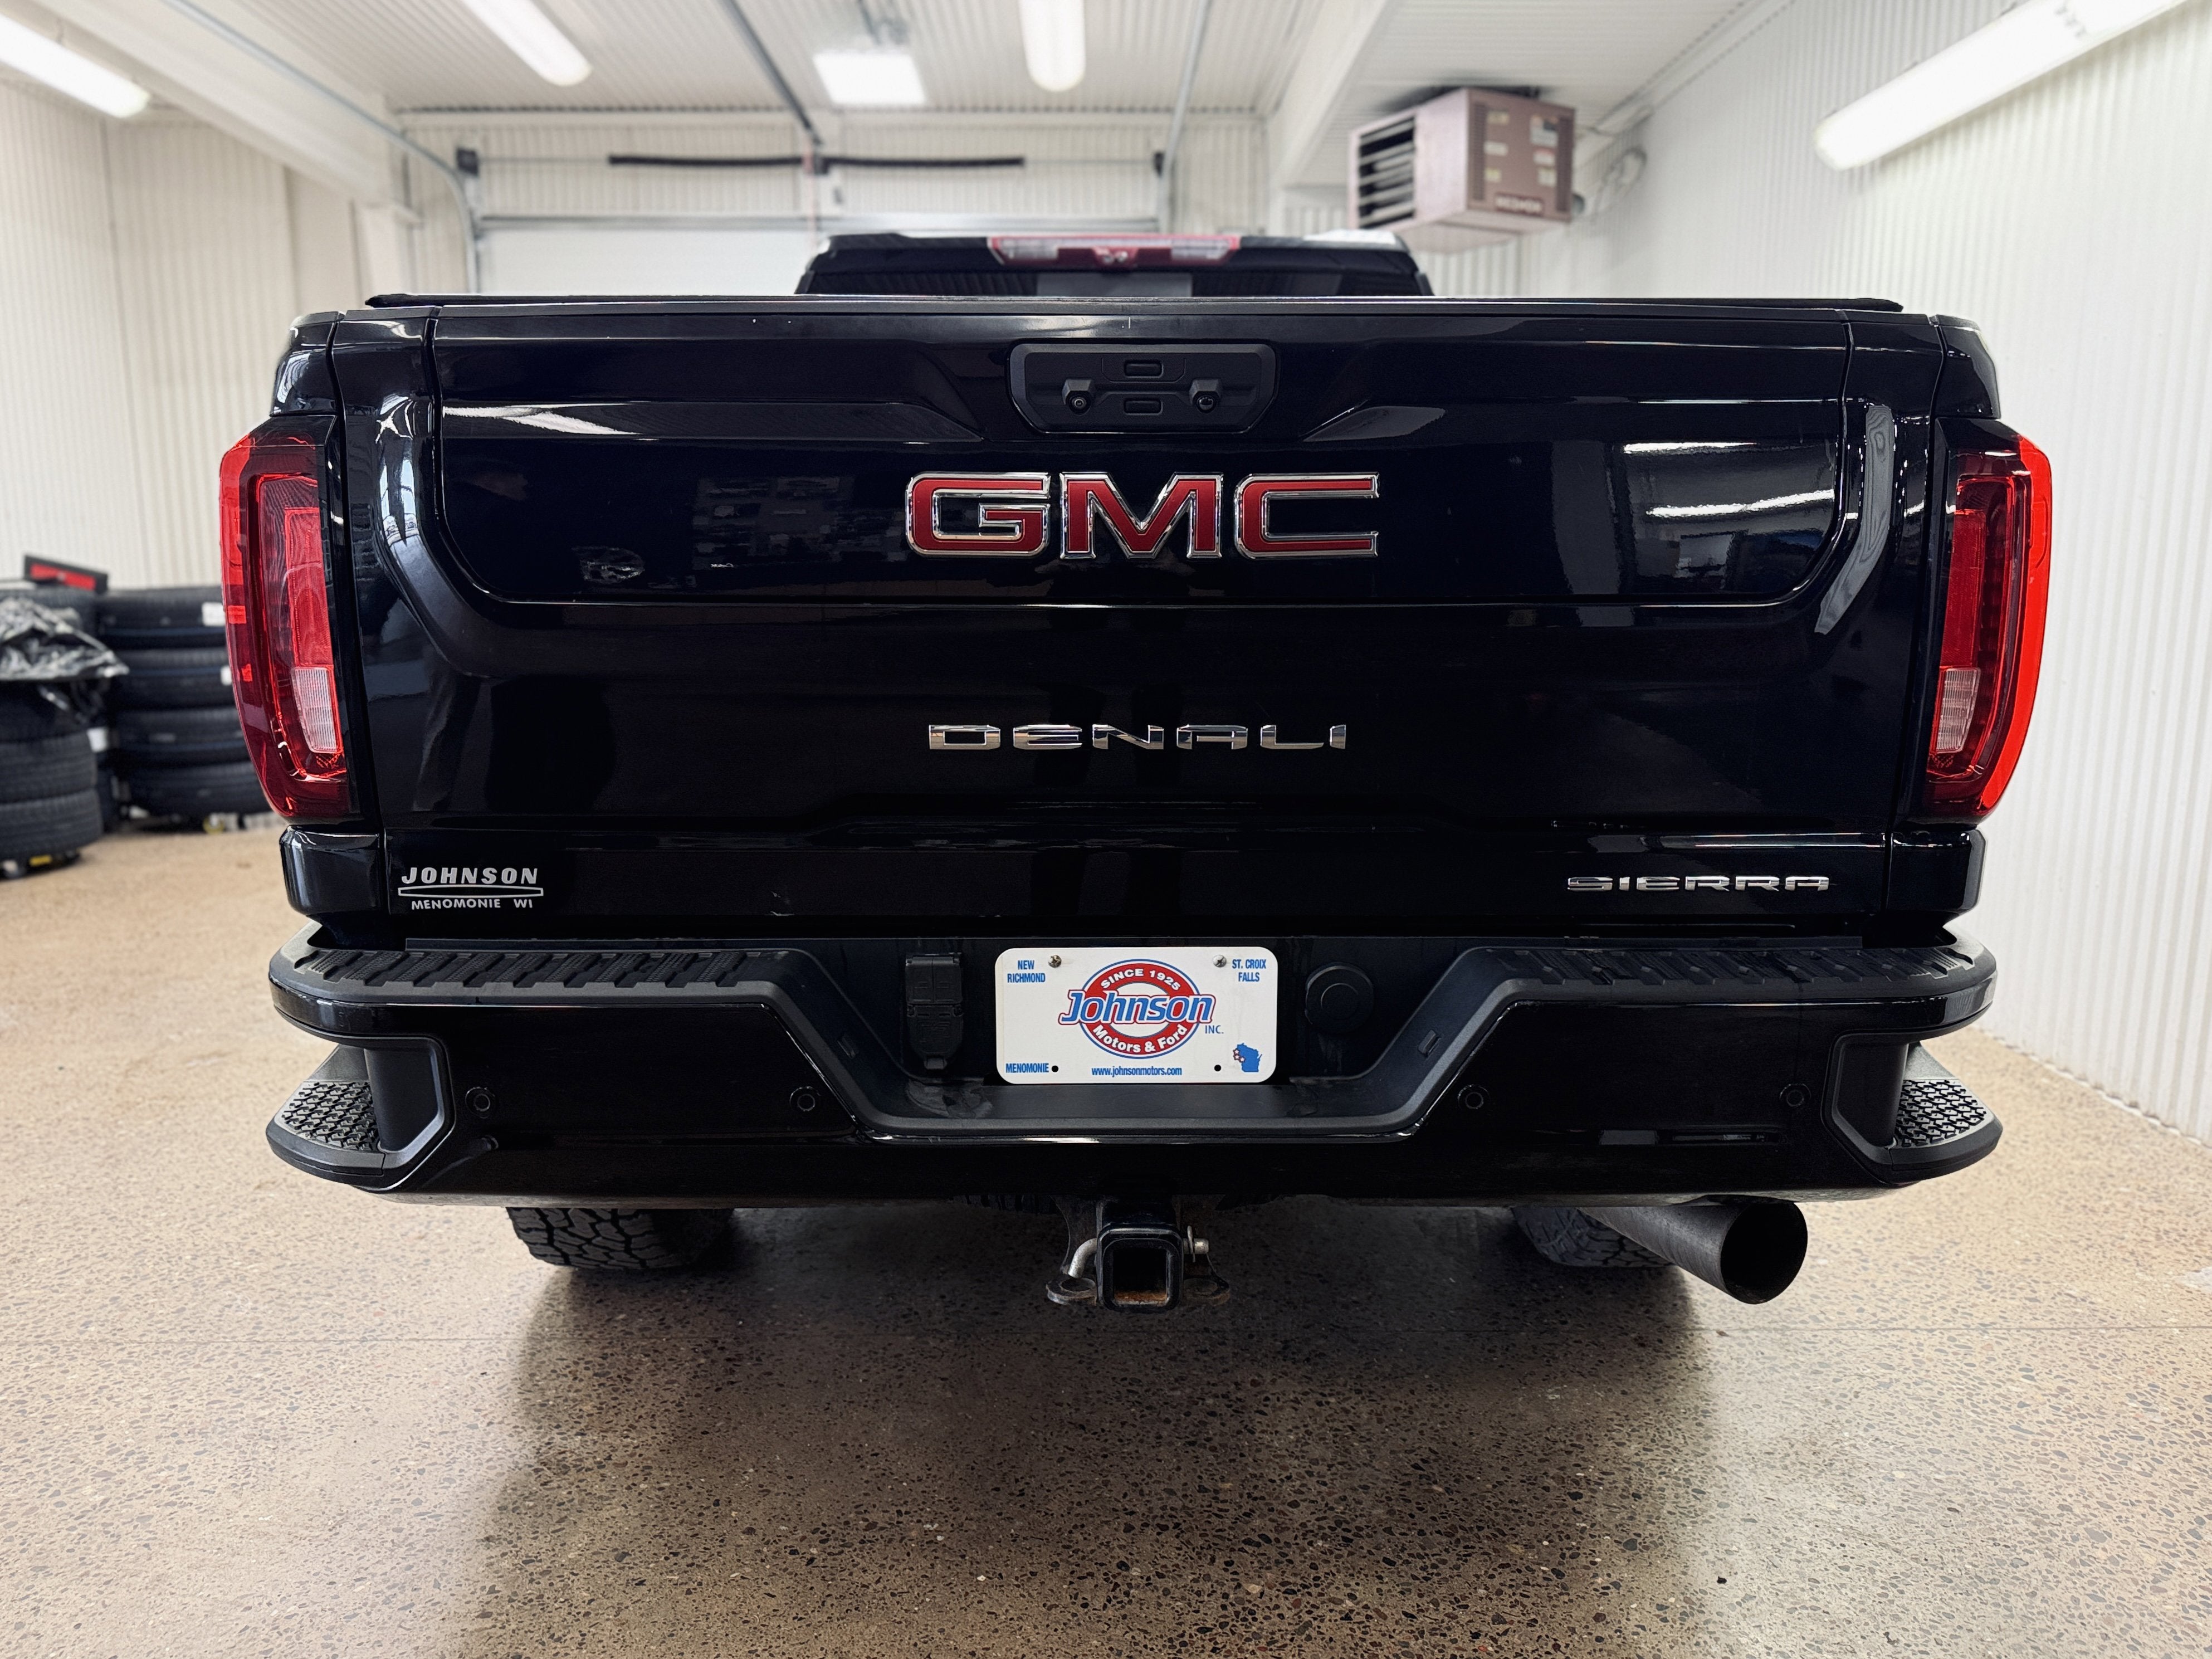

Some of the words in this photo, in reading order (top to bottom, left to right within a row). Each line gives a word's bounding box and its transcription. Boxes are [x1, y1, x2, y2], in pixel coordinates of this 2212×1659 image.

[905, 472, 1380, 558] GMC
[929, 724, 1346, 750] DENALI
[401, 867, 538, 884] JOHNSON
[1567, 876, 1830, 891] SIERRA
[411, 898, 501, 910] MENOMONIE
[513, 899, 533, 909] WI
[1017, 960, 1035, 970] NEW
[1232, 959, 1244, 969] ST.
[1245, 959, 1267, 969] CROIX
[1007, 973, 1046, 984] RICHMOND
[1100, 968, 1144, 990] SINCE
[1149, 969, 1182, 992] 1925
[1238, 972, 1261, 983] FALLS
[1059, 990, 1215, 1024] Johnson
[1204, 1024, 1224, 1035] INC.
[1092, 1024, 1141, 1053] Motors
[1144, 1042, 1156, 1053] &
[1158, 1023, 1188, 1050] Ford
[1005, 1063, 1049, 1074] MENOMONIE
[1091, 1066, 1183, 1078] www.johnsonmotors.com
